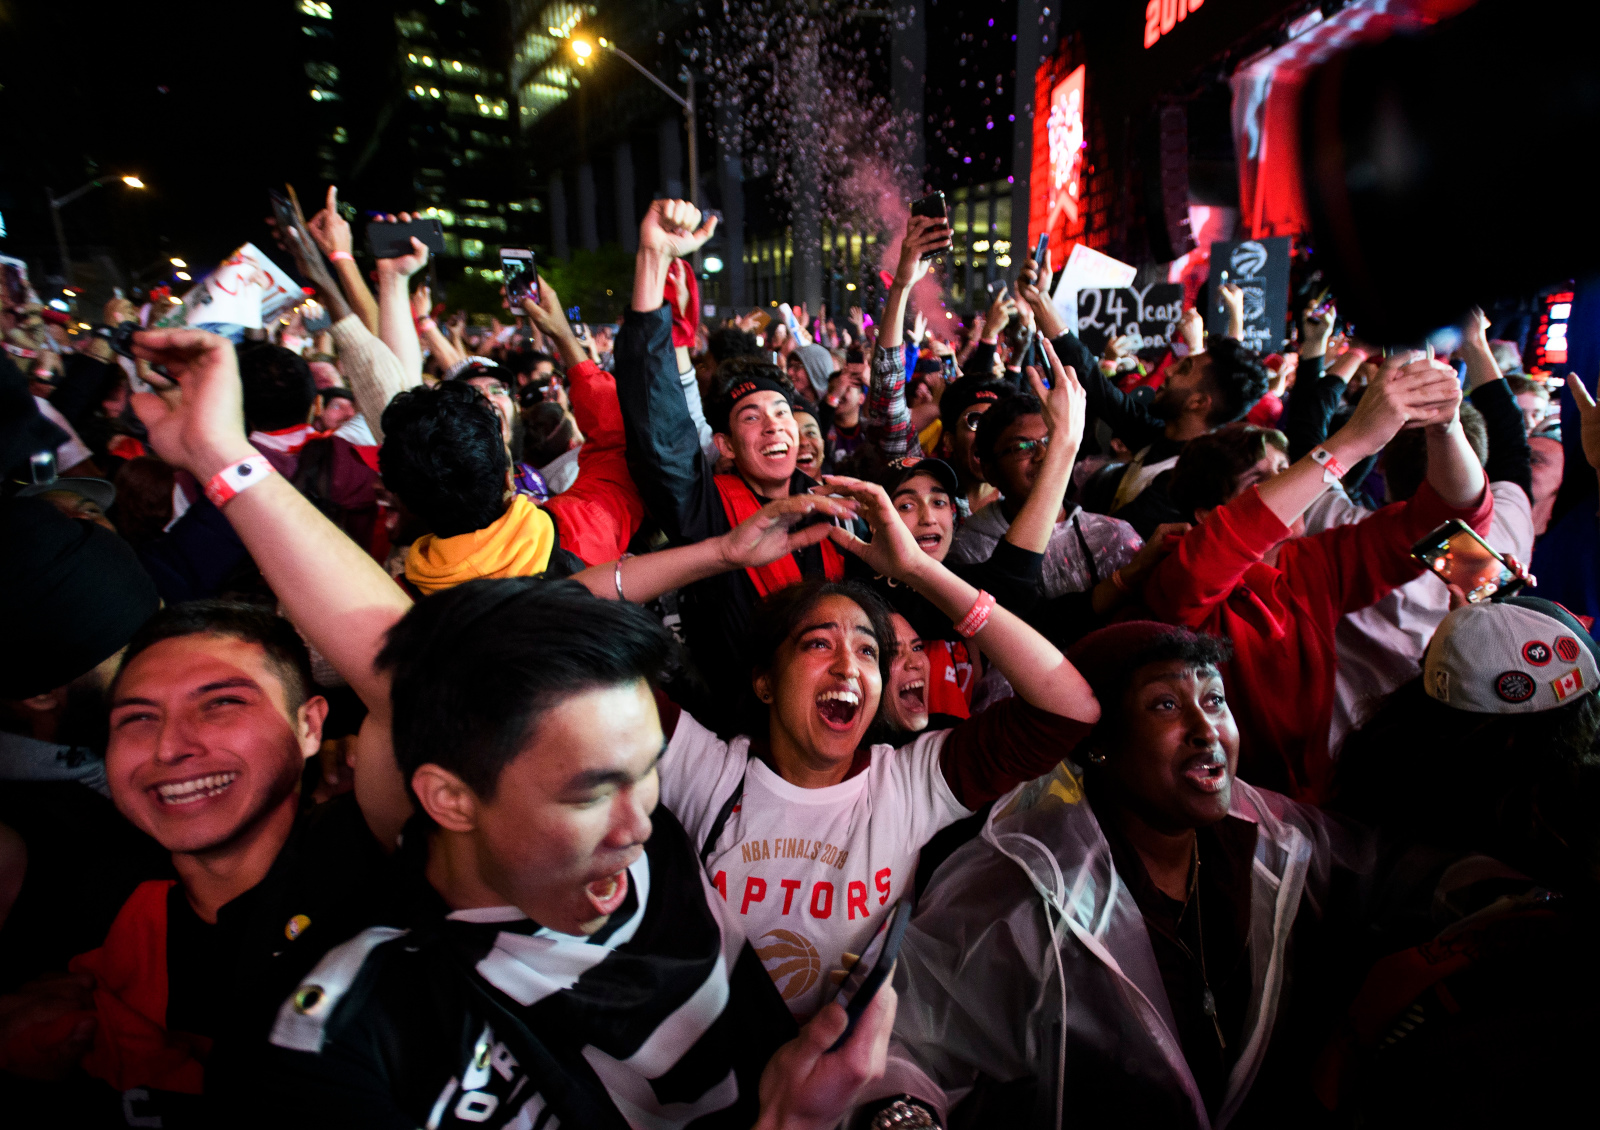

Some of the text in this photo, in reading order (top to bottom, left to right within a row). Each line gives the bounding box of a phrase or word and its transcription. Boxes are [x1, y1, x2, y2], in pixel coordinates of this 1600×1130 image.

[1078, 287, 1129, 331] 24
[741, 837, 849, 870] NBA FINALS 2019
